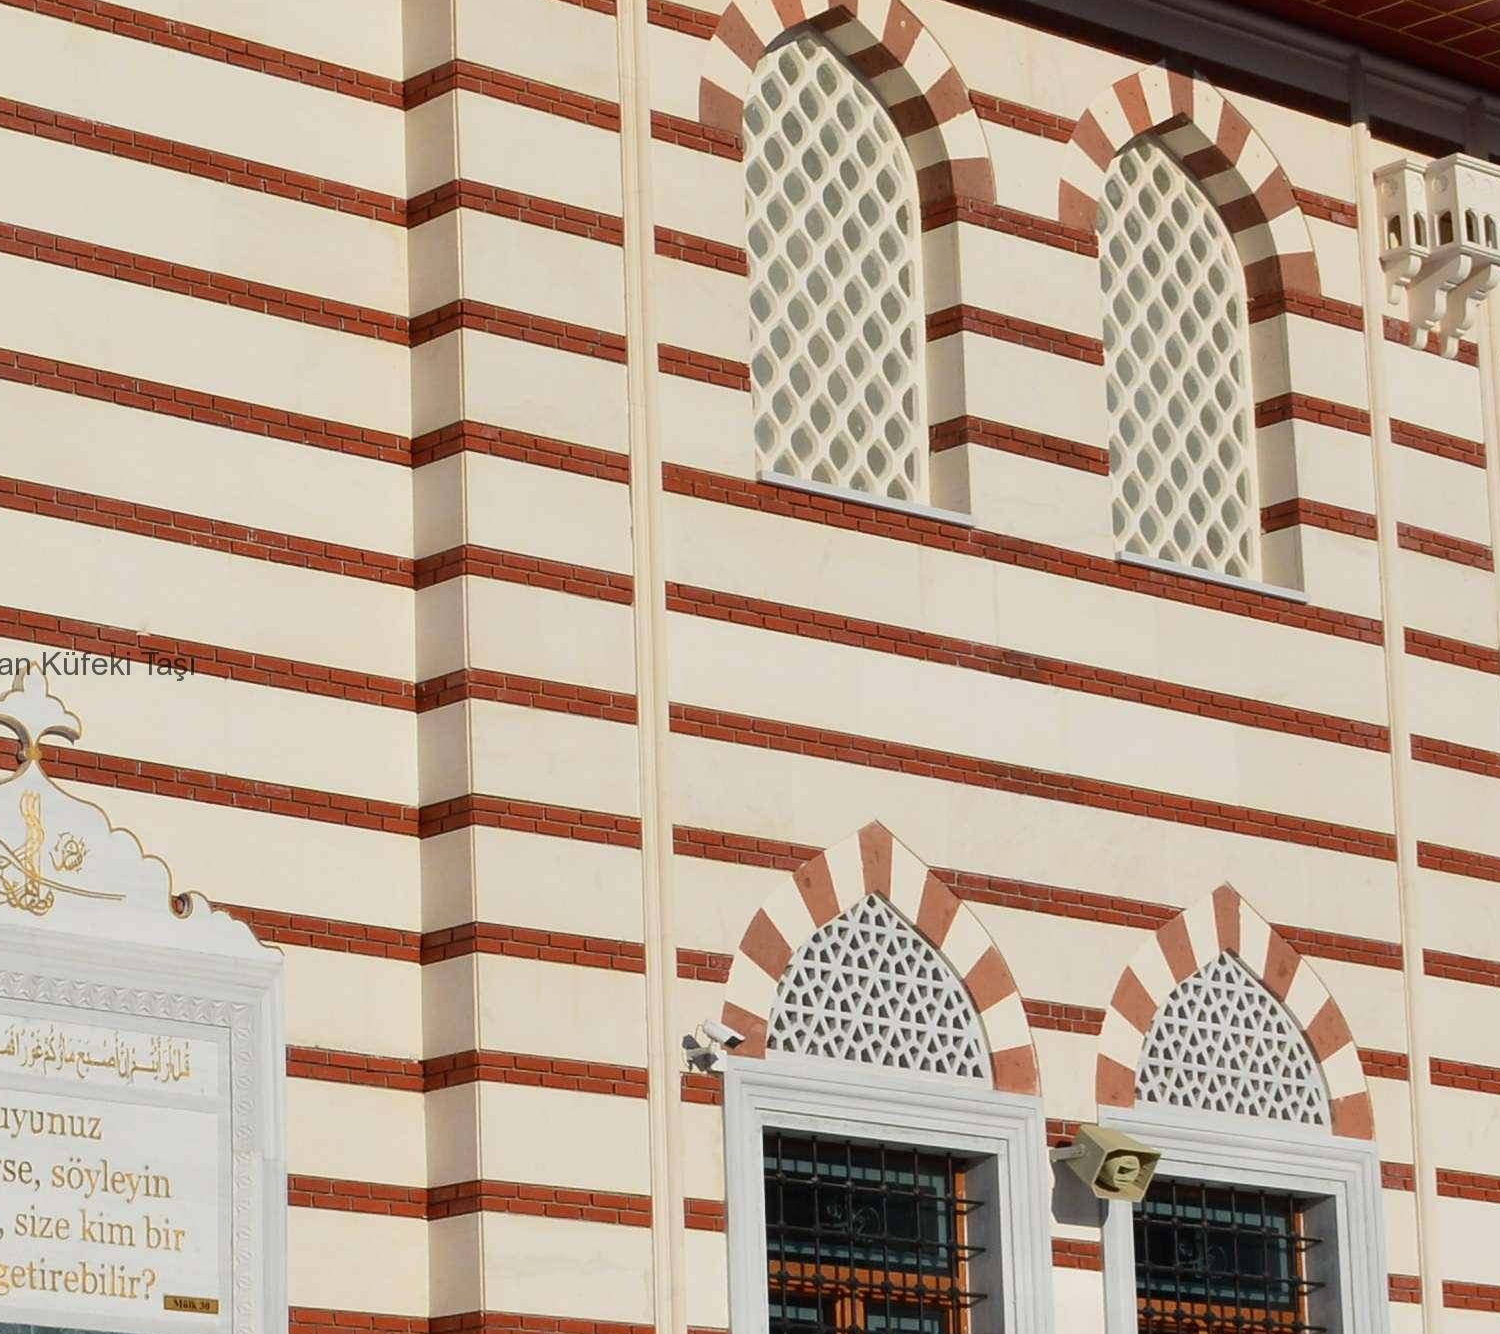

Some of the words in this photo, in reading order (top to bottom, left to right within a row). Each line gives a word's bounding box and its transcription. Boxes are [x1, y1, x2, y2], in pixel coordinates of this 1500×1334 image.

[51, 1157, 171, 1203] söyleyin
[14, 1205, 70, 1239] size
[80, 1209, 136, 1247] kim
[144, 1216, 185, 1251] bir
